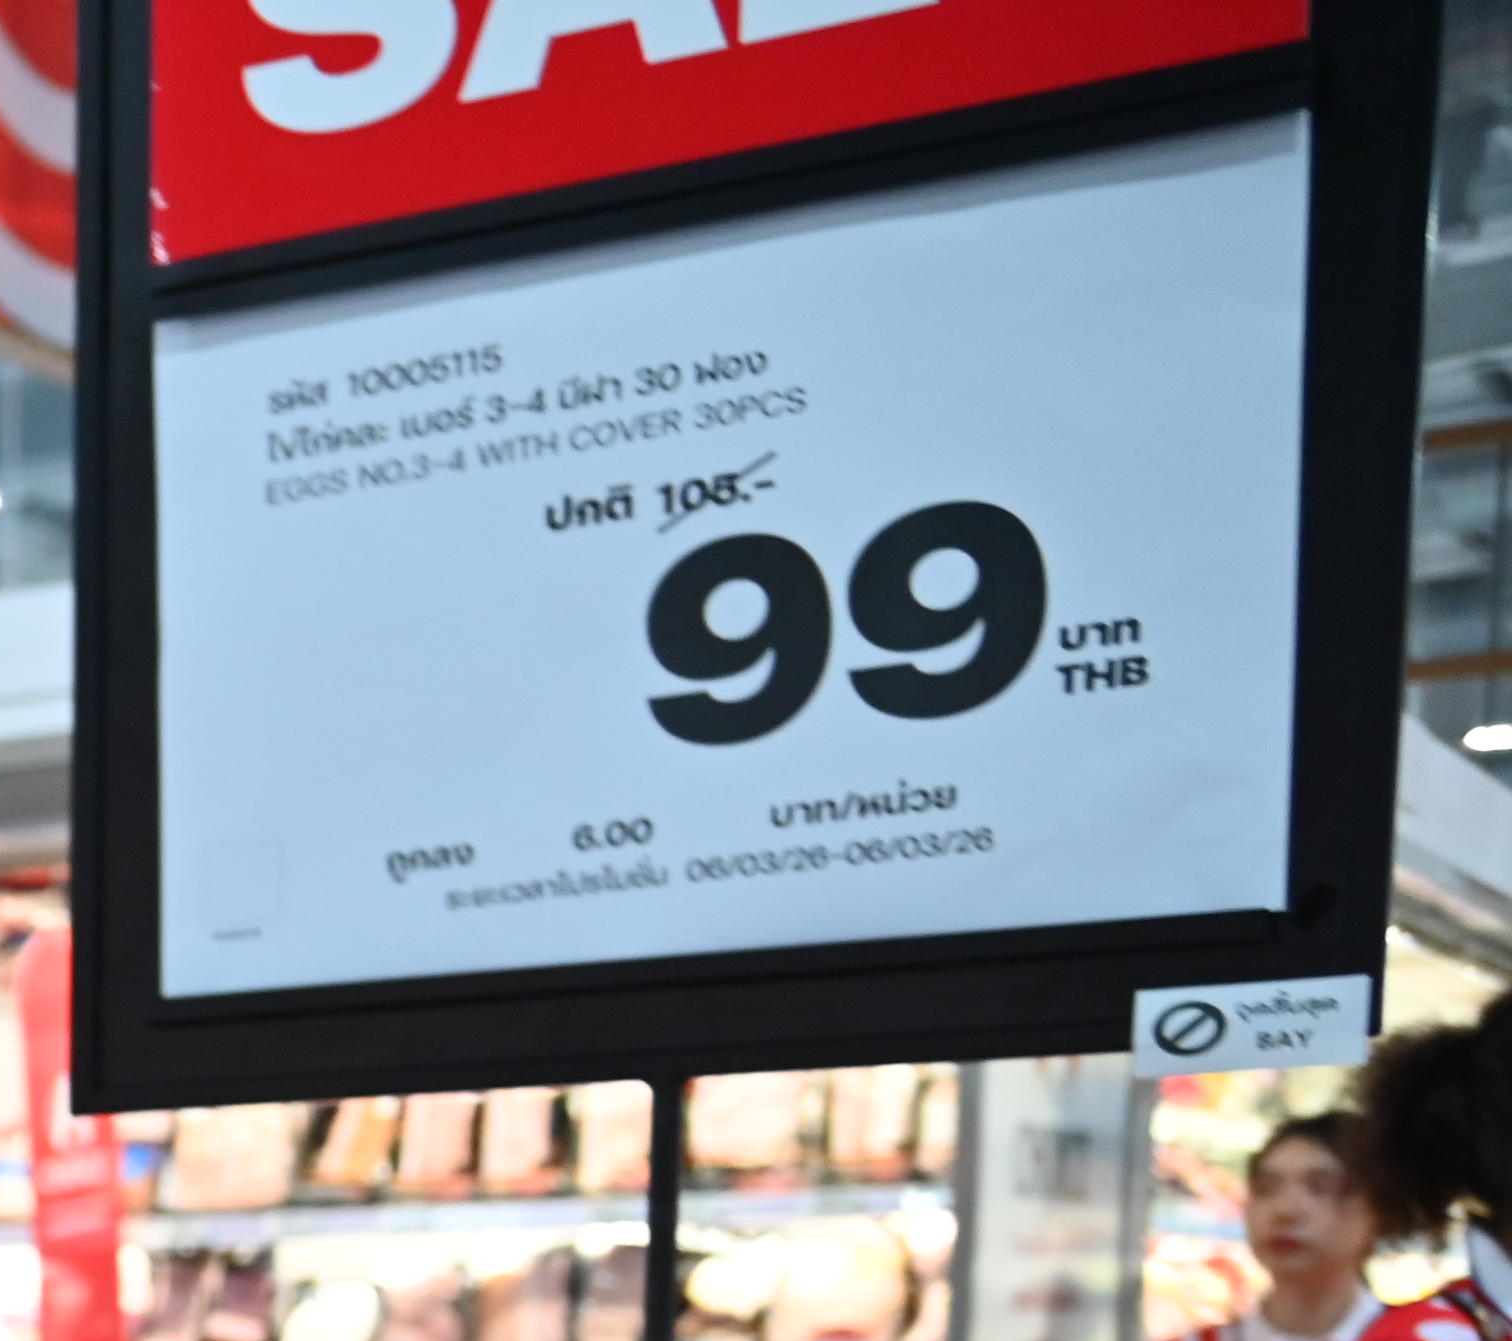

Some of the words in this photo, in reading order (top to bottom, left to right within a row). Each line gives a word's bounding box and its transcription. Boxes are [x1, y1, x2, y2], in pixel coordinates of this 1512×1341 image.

[347, 345, 504, 398] 10005115
[486, 388, 546, 423] 3-4
[634, 362, 682, 398] 30
[266, 468, 349, 505] EGGS
[479, 428, 560, 469] WITH
[569, 409, 683, 454] COVER
[694, 386, 809, 432] 30PCS
[647, 499, 1047, 746] 99
[1059, 616, 1142, 651] บาท
[1056, 656, 1151, 695] THB
[571, 815, 656, 852] 6.00
